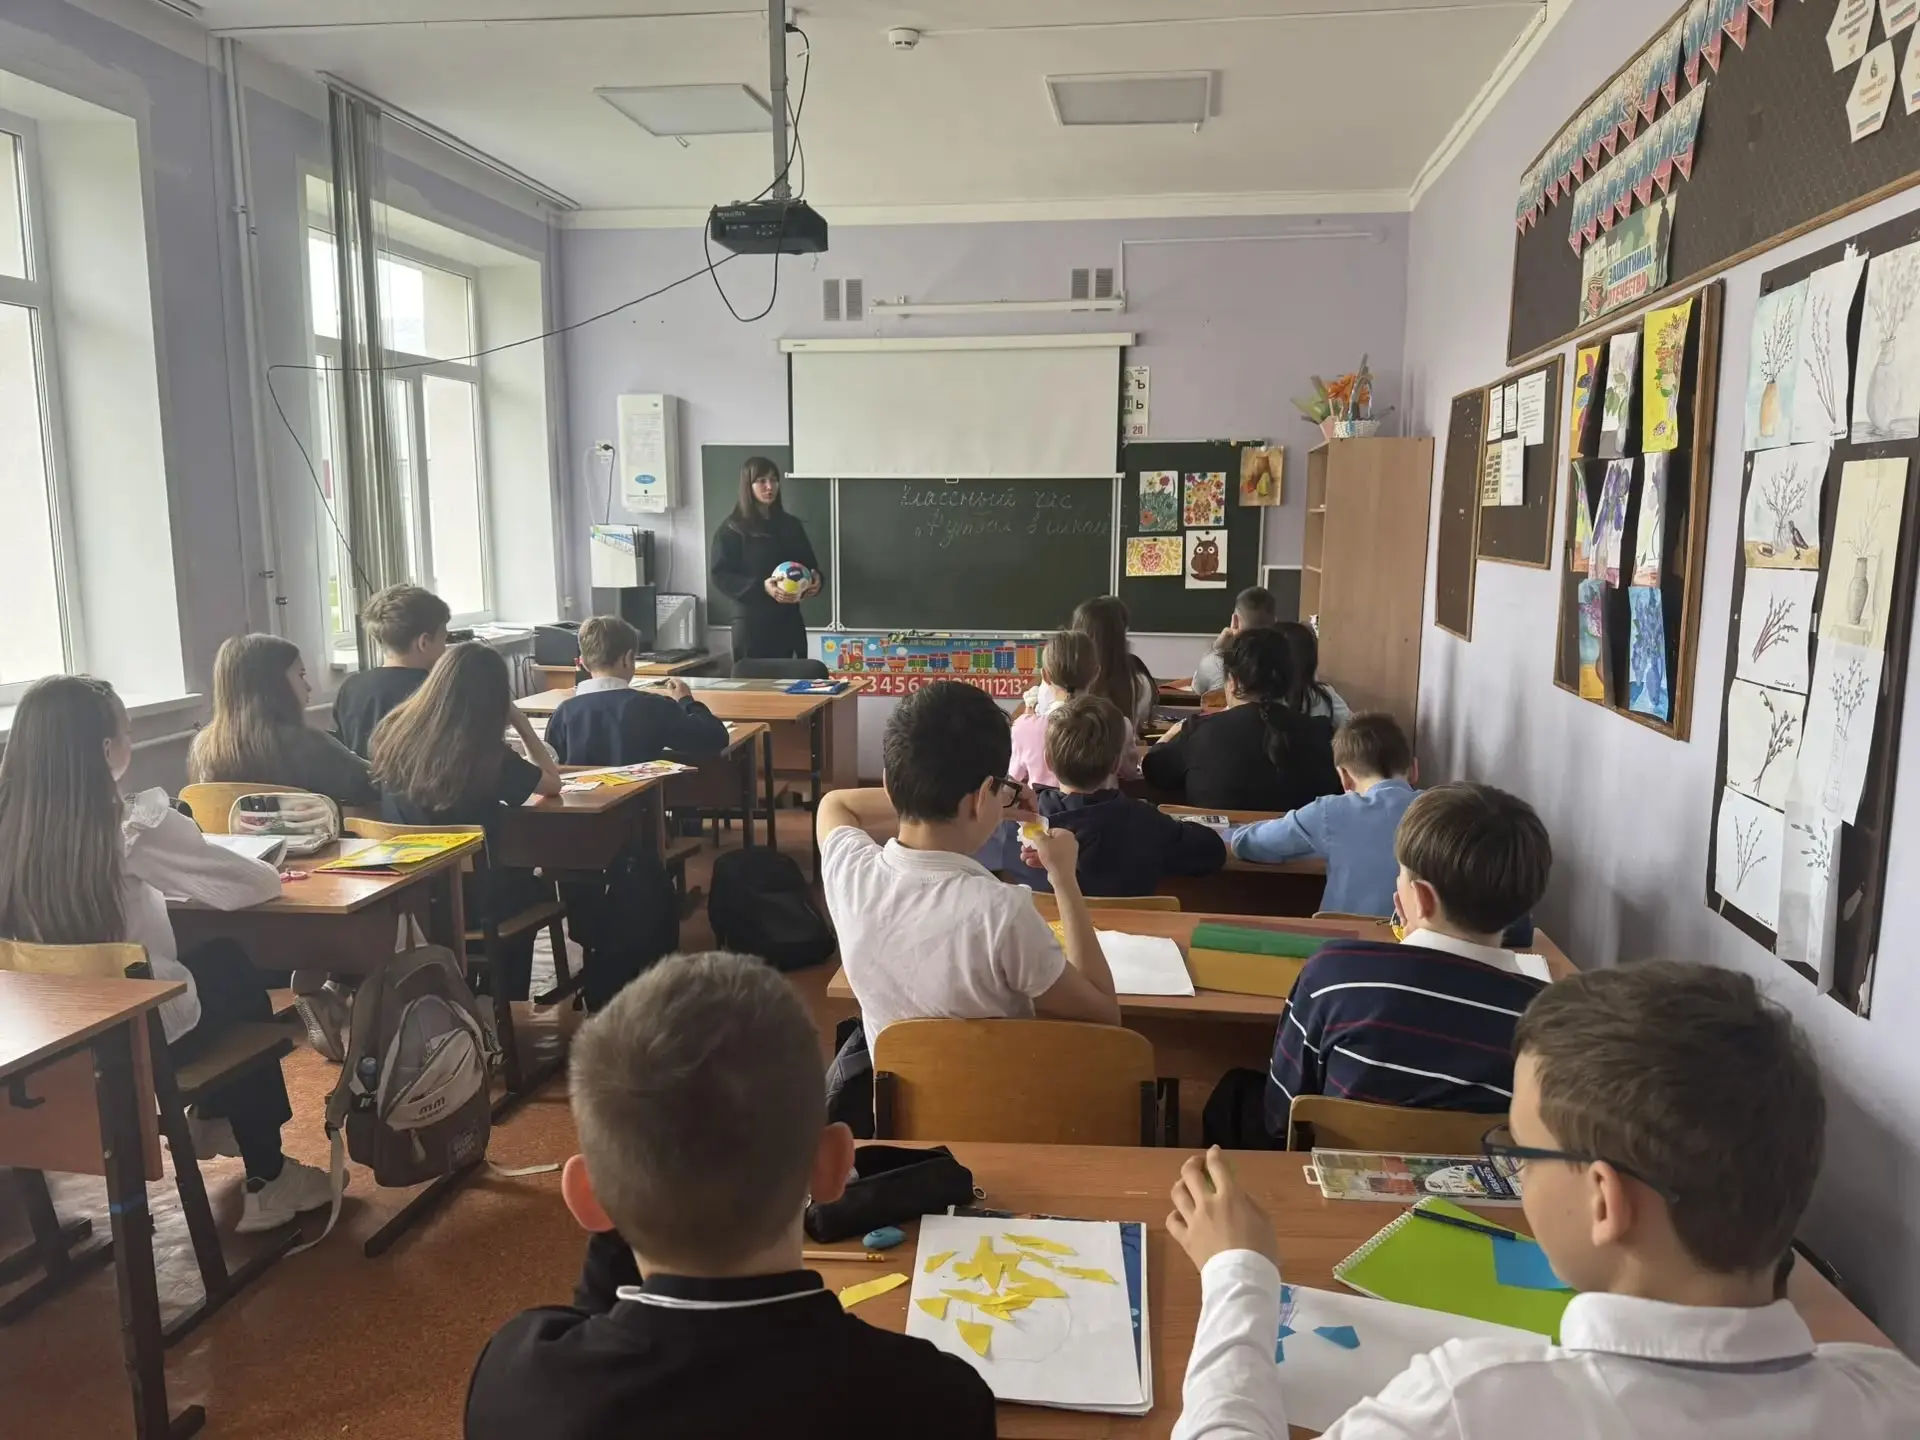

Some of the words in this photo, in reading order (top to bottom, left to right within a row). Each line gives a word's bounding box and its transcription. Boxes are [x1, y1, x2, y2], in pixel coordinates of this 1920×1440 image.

[1608, 245, 1652, 286] ЗАЩИТНИКА
[1606, 270, 1648, 307] ОТЕЧЕСТВА
[1132, 425, 1143, 435] 20
[867, 676, 877, 692] 3
[880, 676, 892, 692] 4
[895, 676, 905, 692] 5
[908, 676, 920, 692] 6
[994, 678, 1007, 694] 12
[1008, 678, 1022, 694] 13
